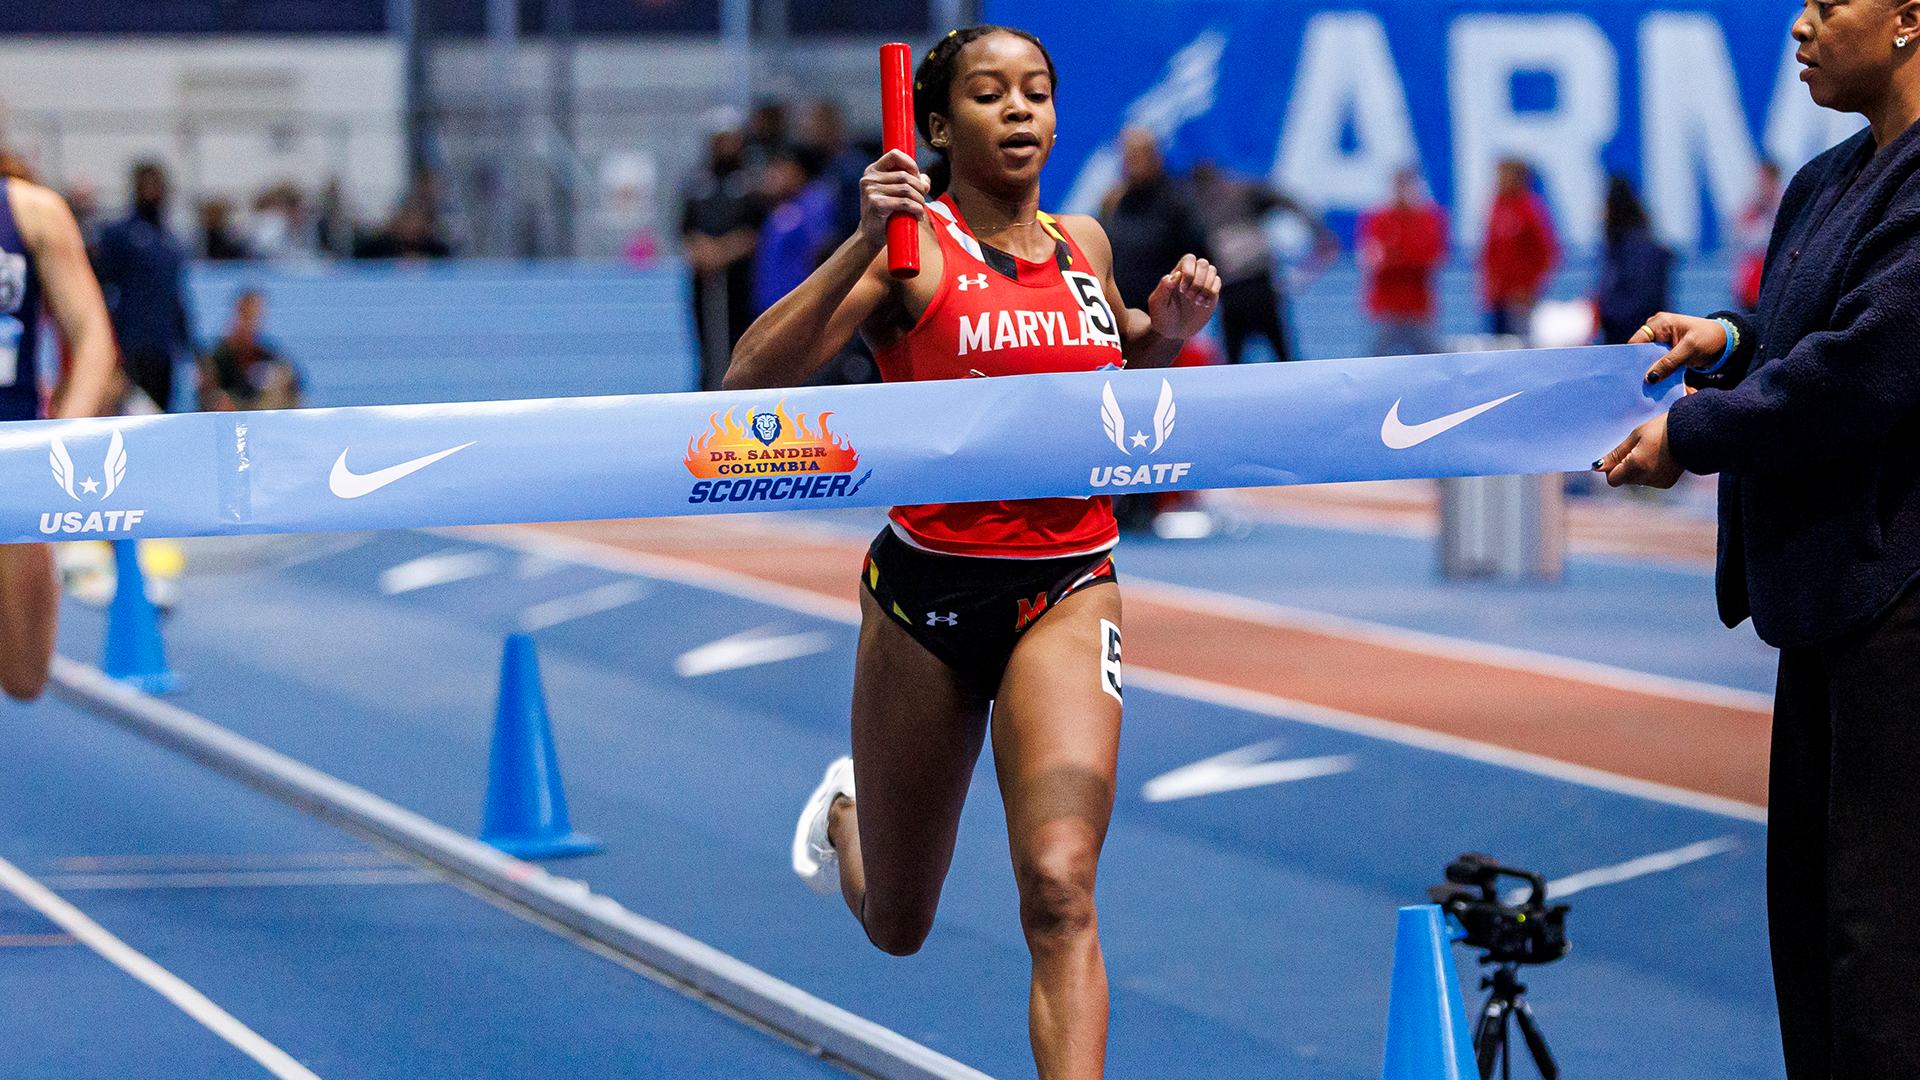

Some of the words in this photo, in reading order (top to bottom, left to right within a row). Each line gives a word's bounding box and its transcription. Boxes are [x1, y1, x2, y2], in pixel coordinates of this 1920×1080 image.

[1072, 276, 1115, 336] 5
[957, 310, 1121, 356] MARYLA
[709, 450, 742, 463] DR.
[747, 446, 828, 461] SANDER
[717, 460, 821, 475] COLUMBIA
[1089, 462, 1192, 488] USATF
[688, 474, 852, 504] SCORCHER
[39, 509, 145, 534] USATF
